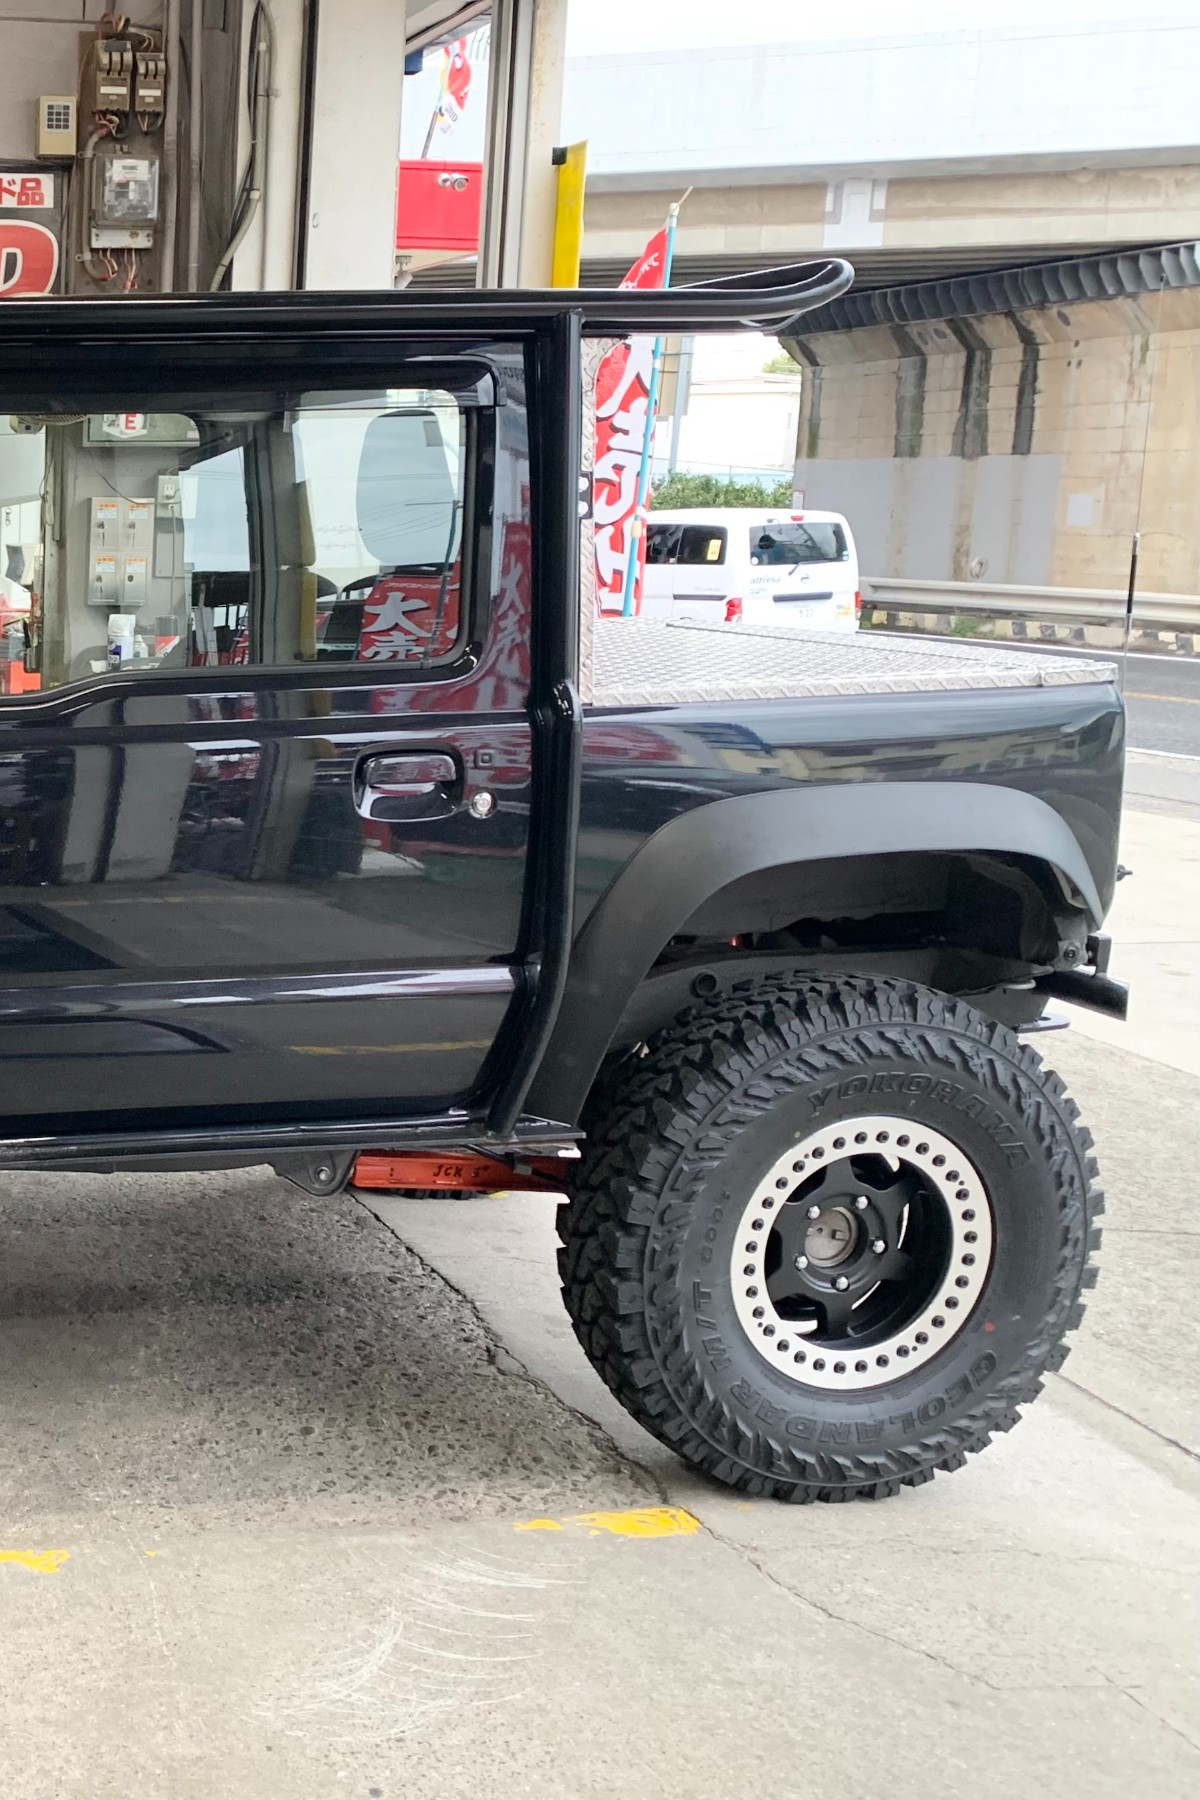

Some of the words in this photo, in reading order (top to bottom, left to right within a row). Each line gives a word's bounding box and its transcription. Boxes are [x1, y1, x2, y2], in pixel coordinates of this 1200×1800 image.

[806, 1071, 1032, 1170] YOKOHAMA
[692, 1279, 733, 1373] M/T
[730, 1349, 998, 1446] GEOLANDAR
